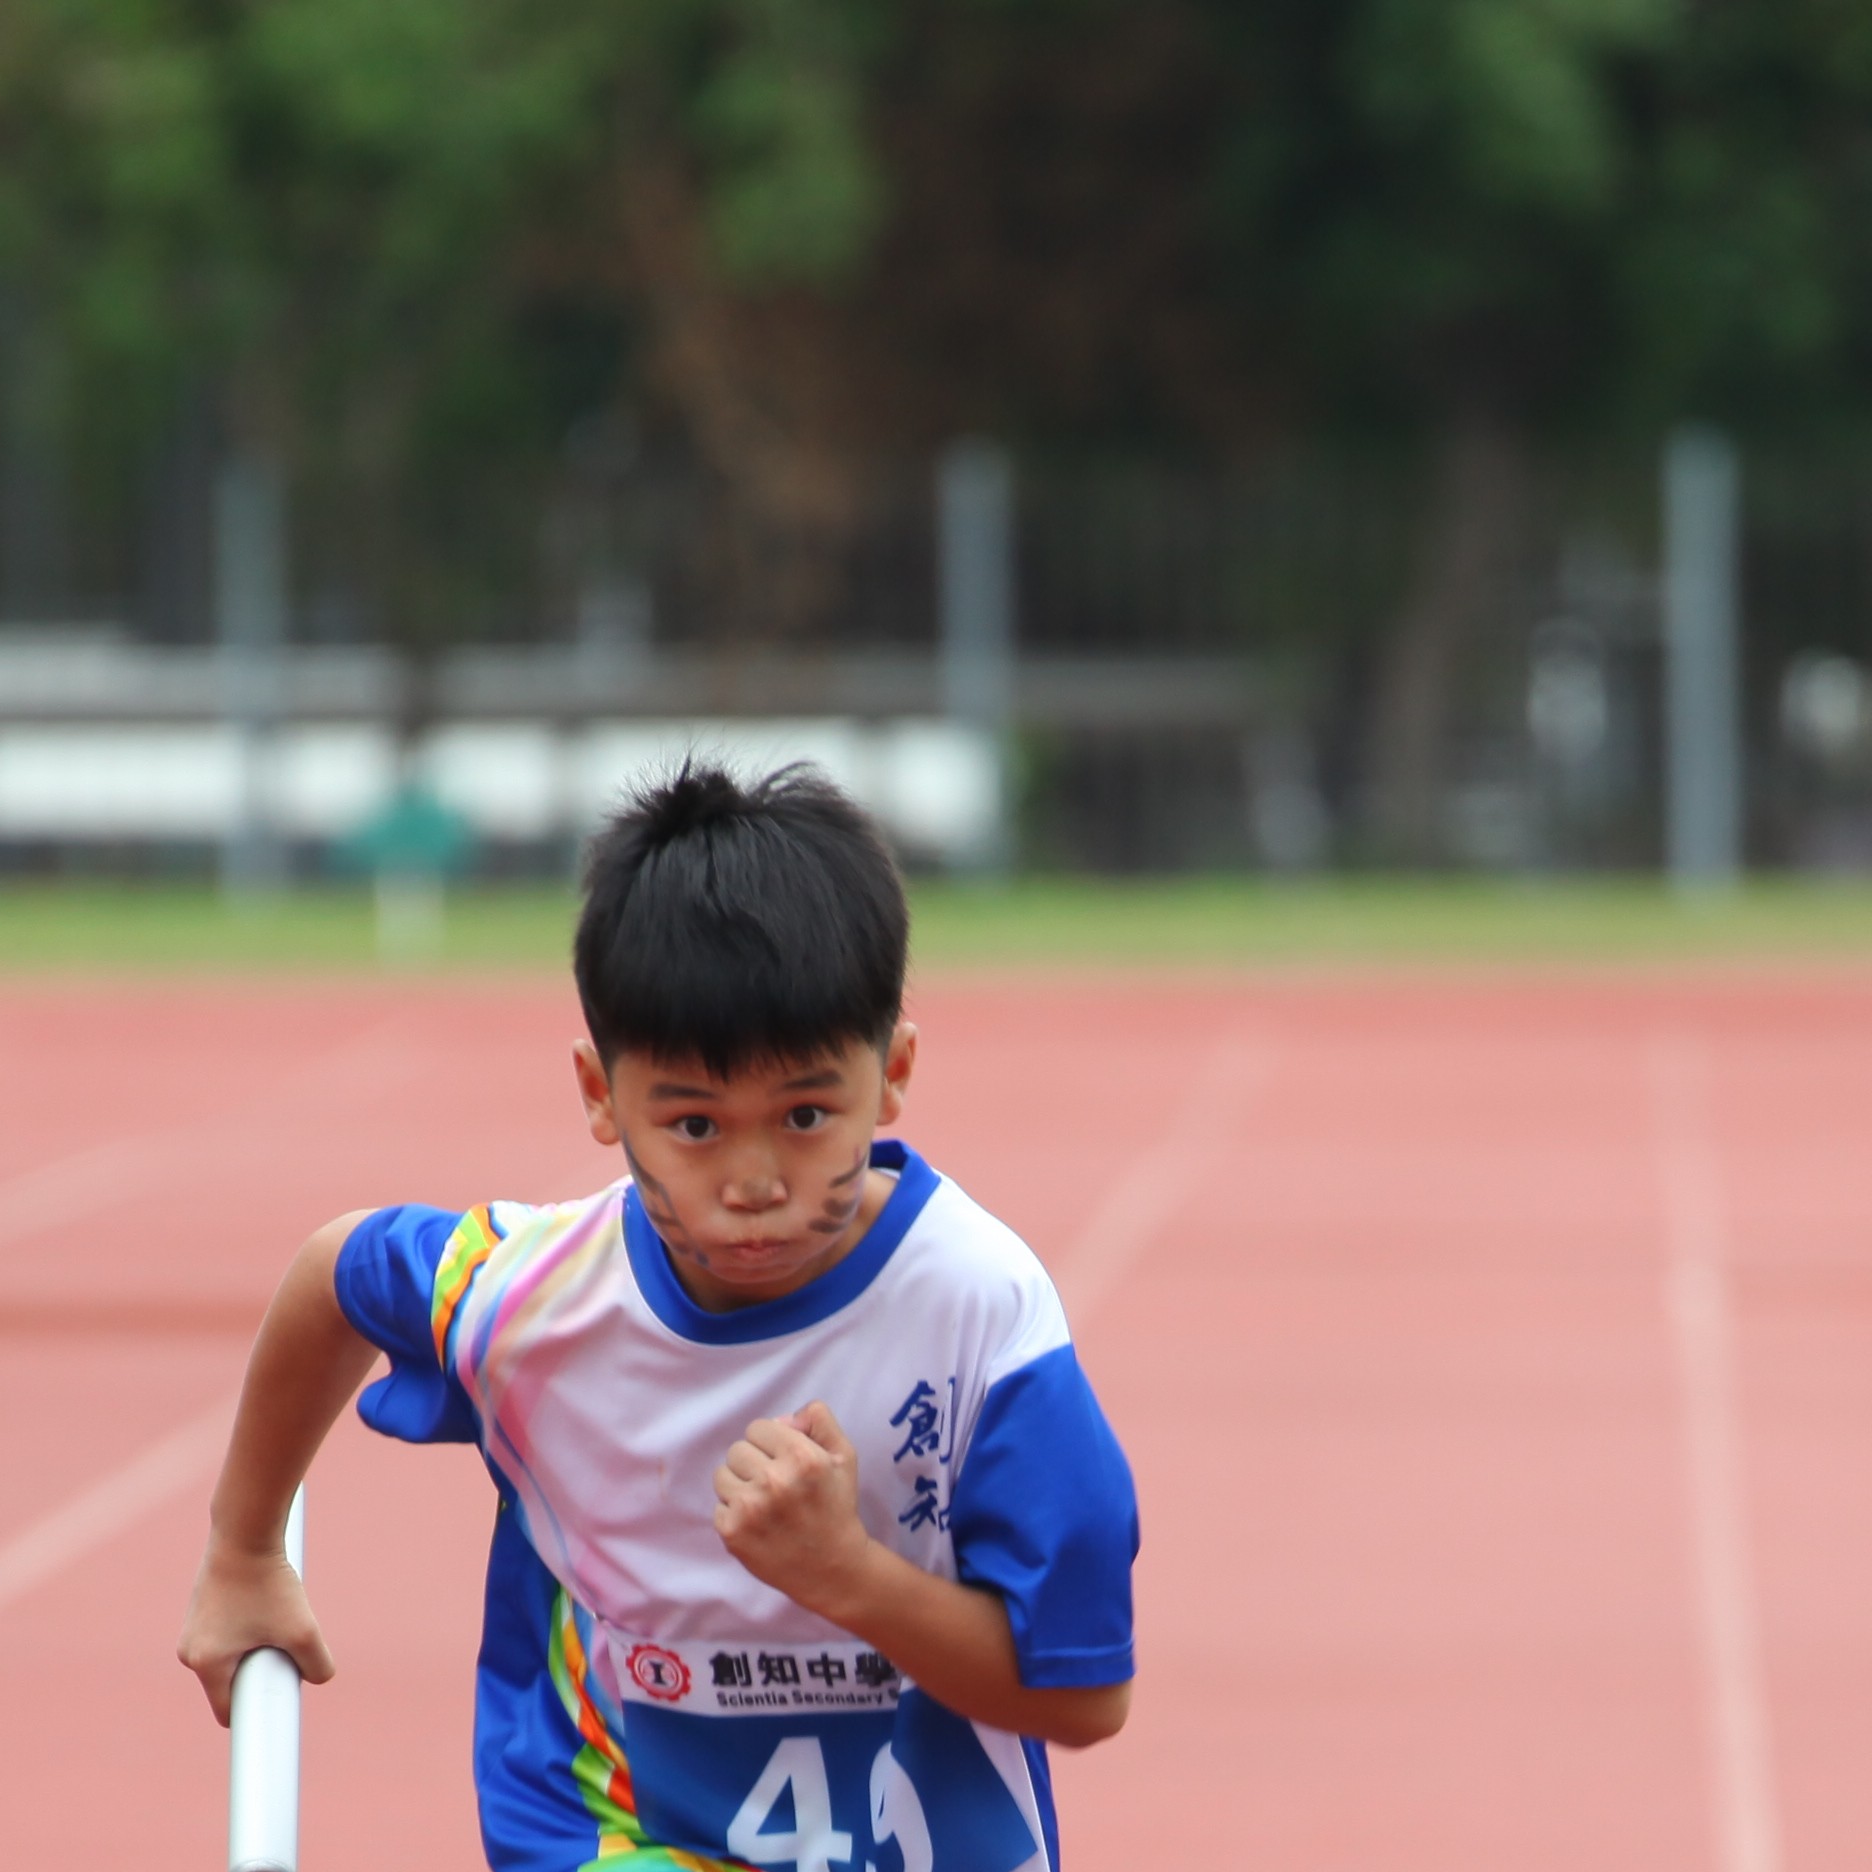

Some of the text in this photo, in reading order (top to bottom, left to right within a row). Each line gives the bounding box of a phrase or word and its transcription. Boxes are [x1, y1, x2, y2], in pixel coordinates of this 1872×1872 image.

[709, 1651, 897, 1688] 創知中學
[715, 1690, 788, 1707] Scientia
[791, 1689, 883, 1707] Secondary
